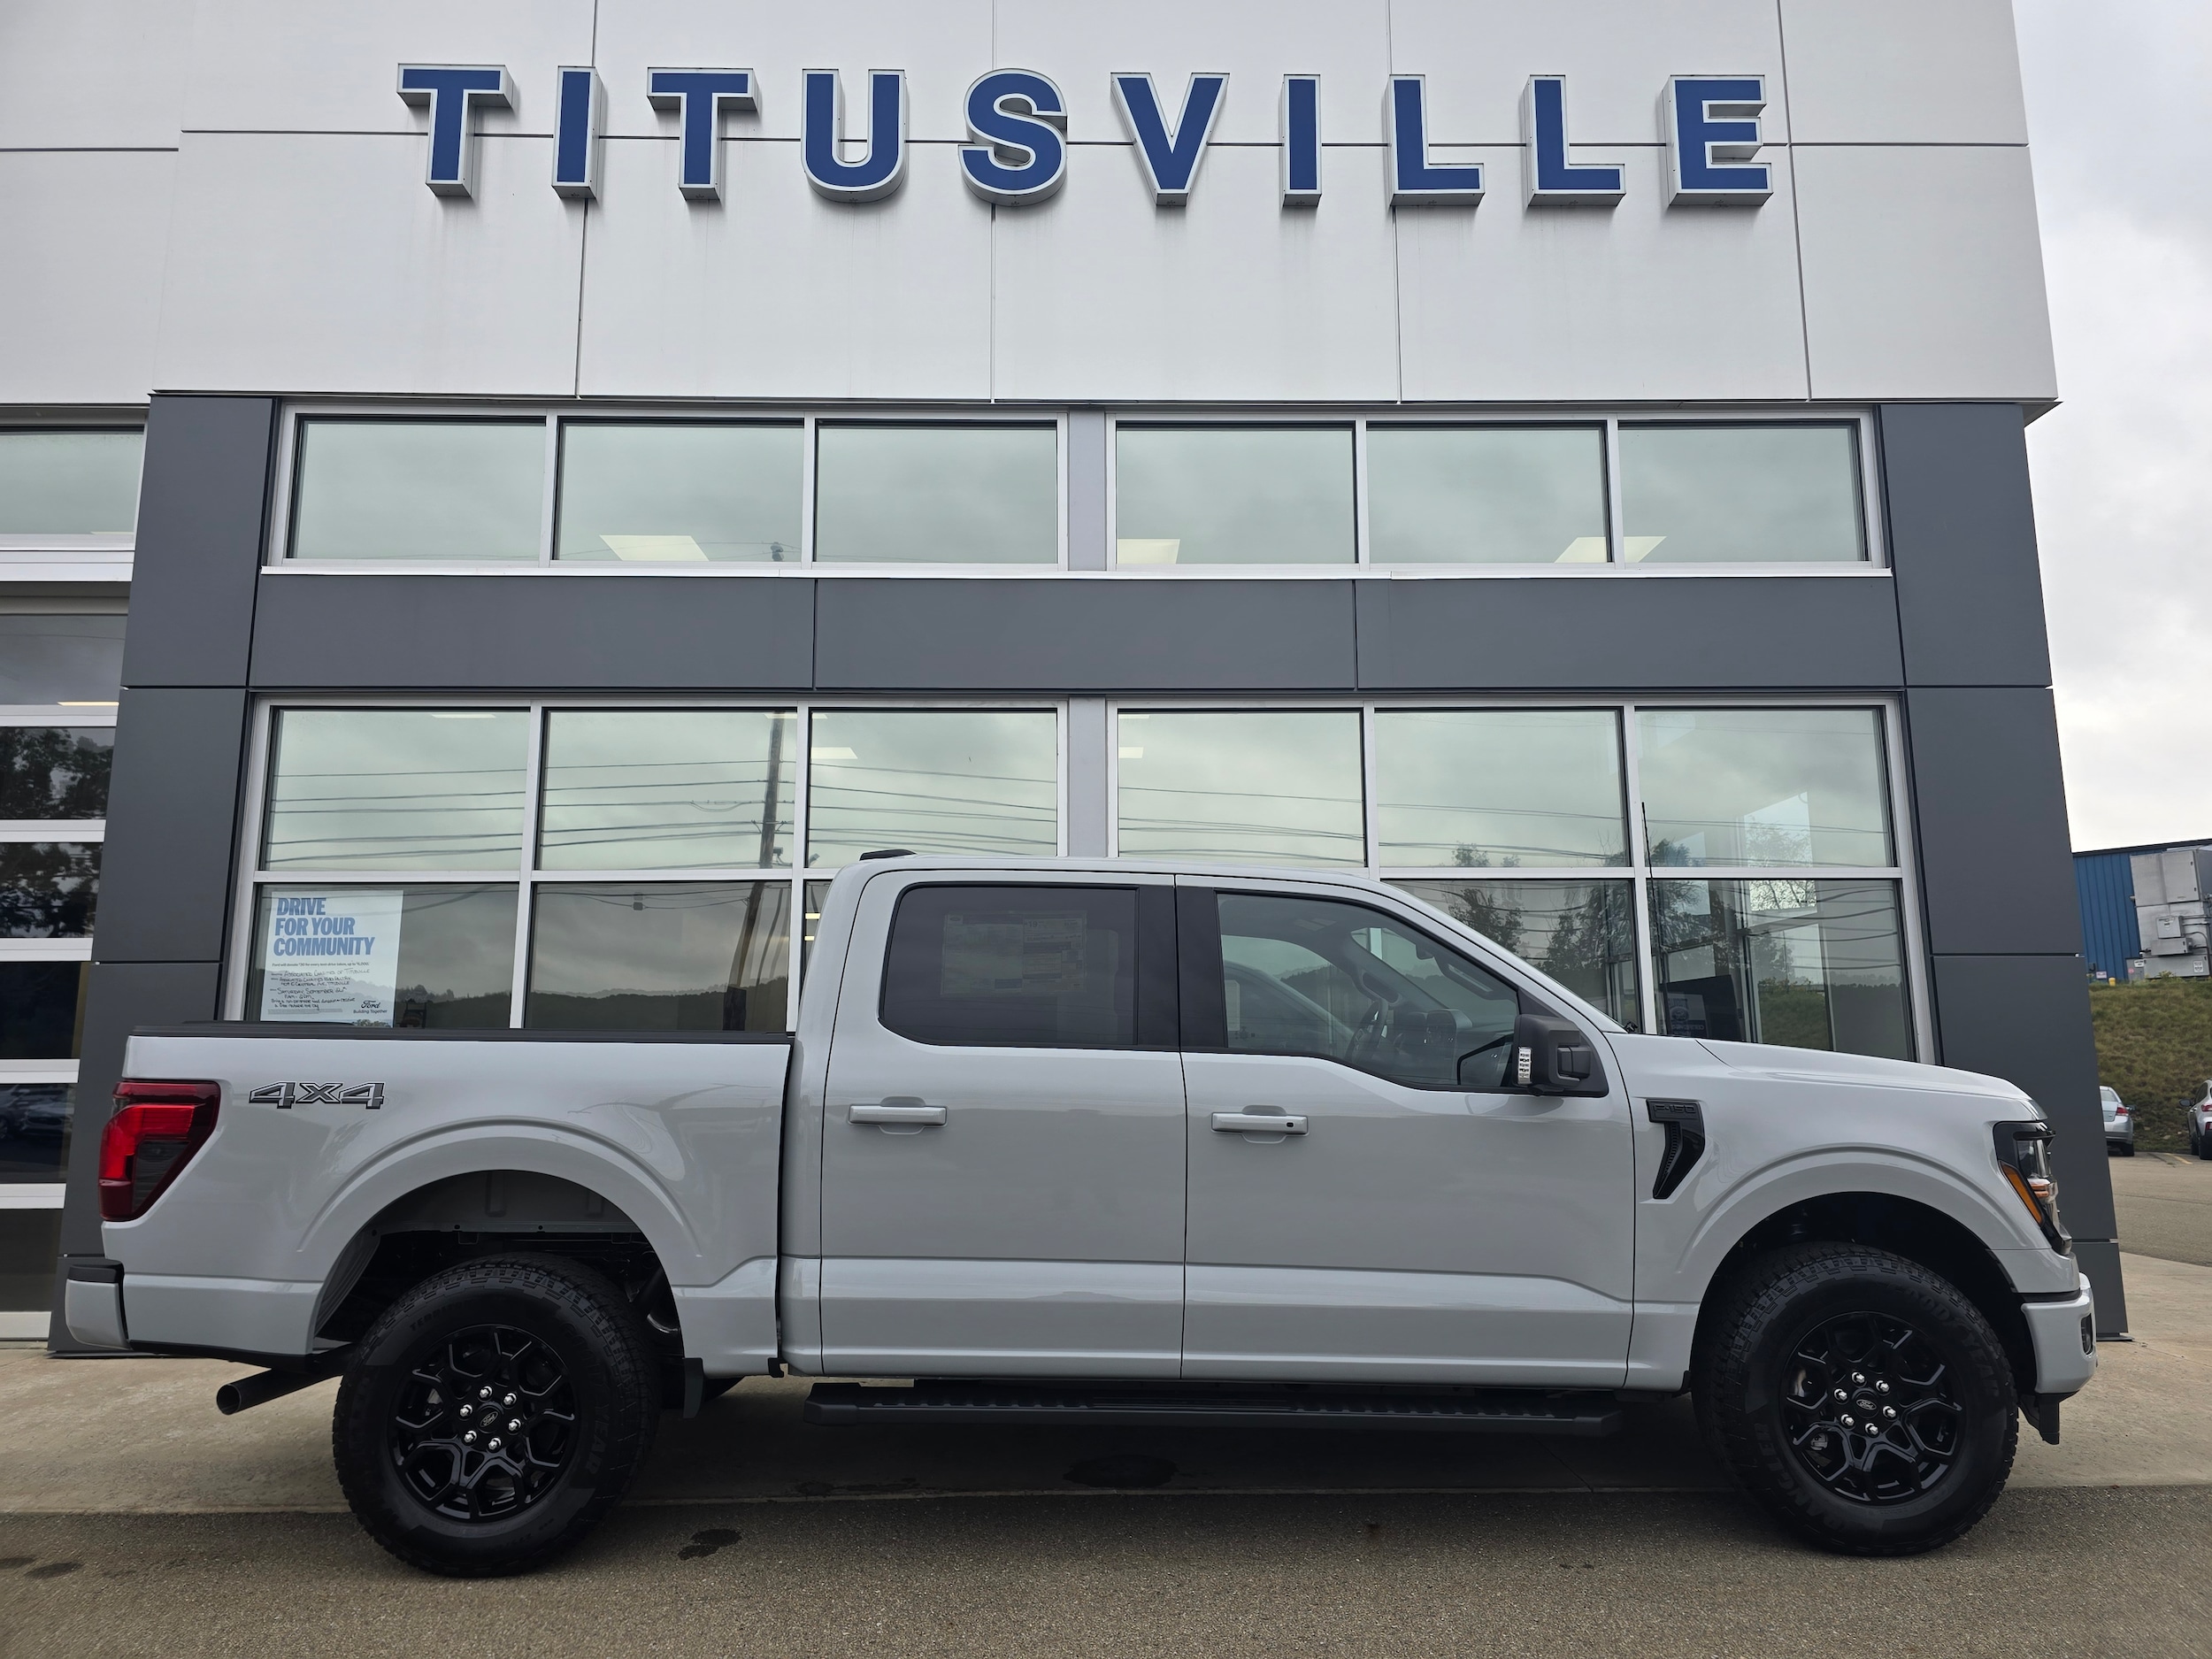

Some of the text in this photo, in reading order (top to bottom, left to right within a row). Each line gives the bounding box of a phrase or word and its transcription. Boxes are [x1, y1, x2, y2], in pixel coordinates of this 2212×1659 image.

[396, 63, 1773, 206] TITUSVILLE
[276, 898, 326, 915] DRIVE
[275, 917, 355, 935] FOR YOUR
[274, 937, 375, 956] COMMUNITY
[361, 1000, 381, 1008] Ford
[1653, 1104, 1697, 1113] F-150
